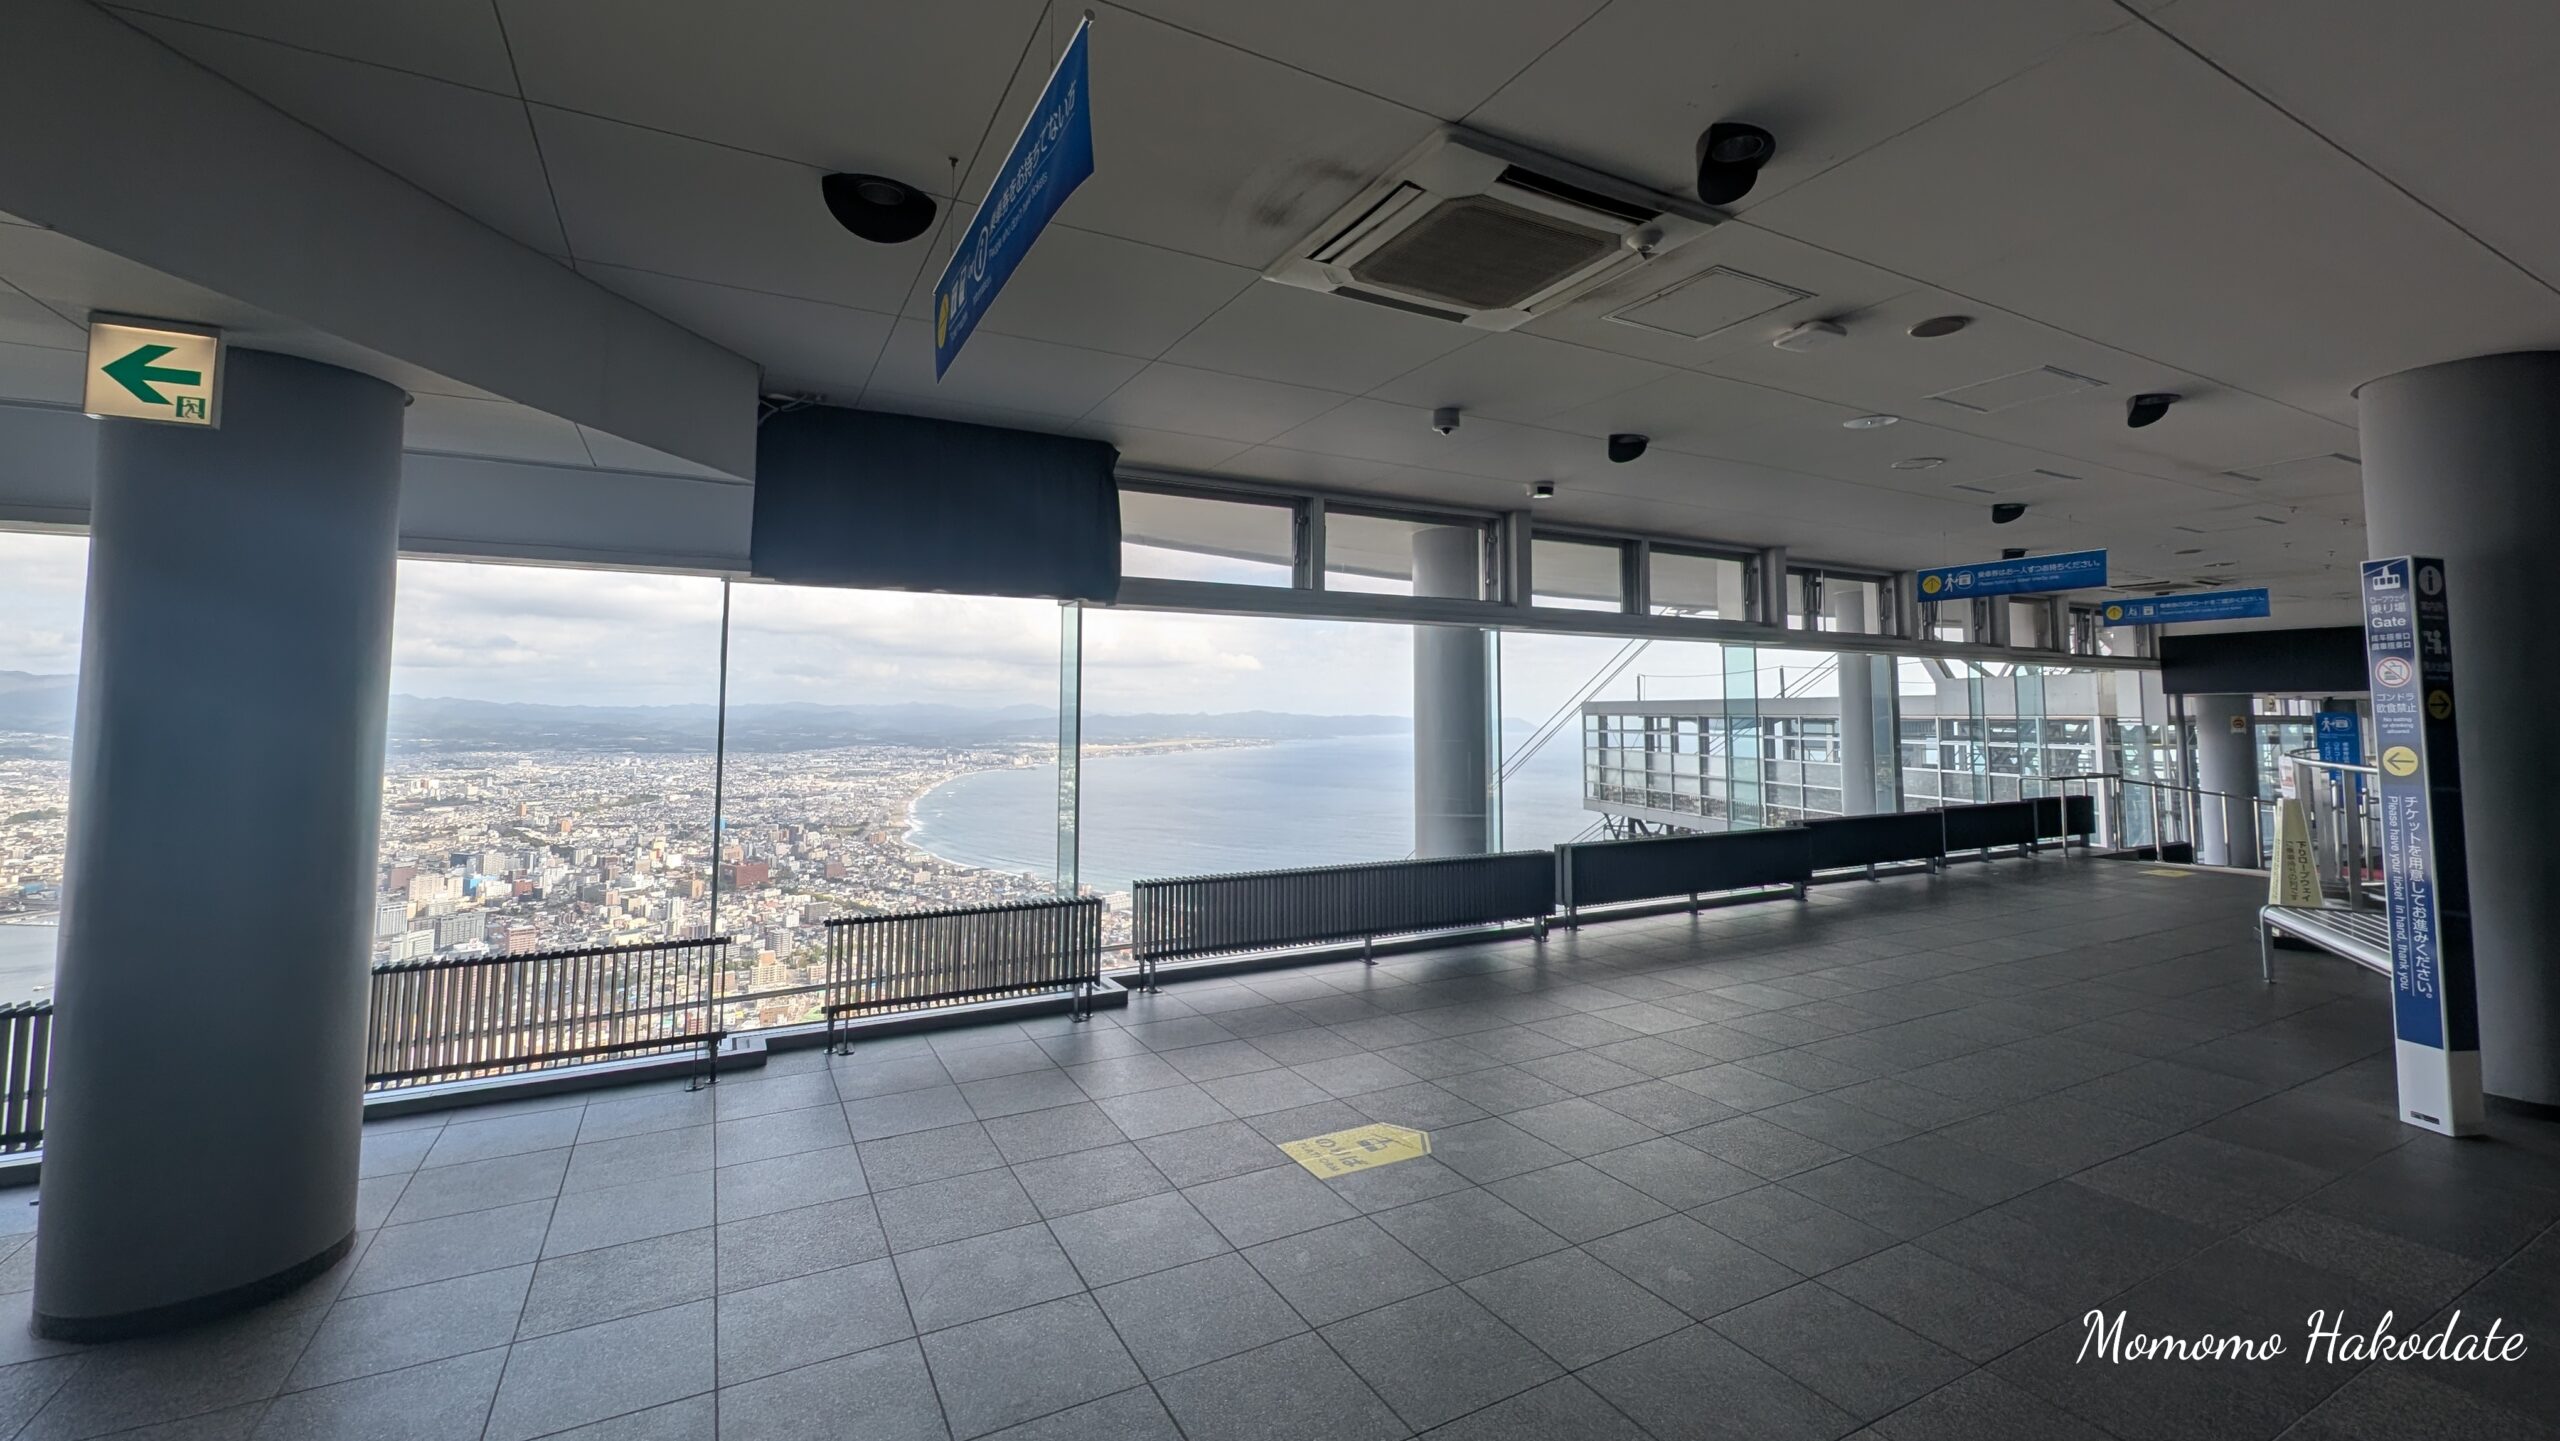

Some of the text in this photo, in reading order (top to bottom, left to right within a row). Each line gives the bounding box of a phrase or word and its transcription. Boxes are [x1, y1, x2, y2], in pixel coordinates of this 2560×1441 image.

[2371, 602, 2406, 614] 乗り場
[2371, 616, 2407, 628] Gate
[2376, 702, 2418, 713] 飲食禁止
[2296, 840, 2312, 902] 下りロープウェイ
[2387, 795, 2410, 991] Please have your ticket in hand, thank you.
[2404, 796, 2433, 999] チケットを用意してお進みください。
[1297, 1142, 1342, 1172] PLATFORM
[1315, 1138, 1369, 1168] のりば
